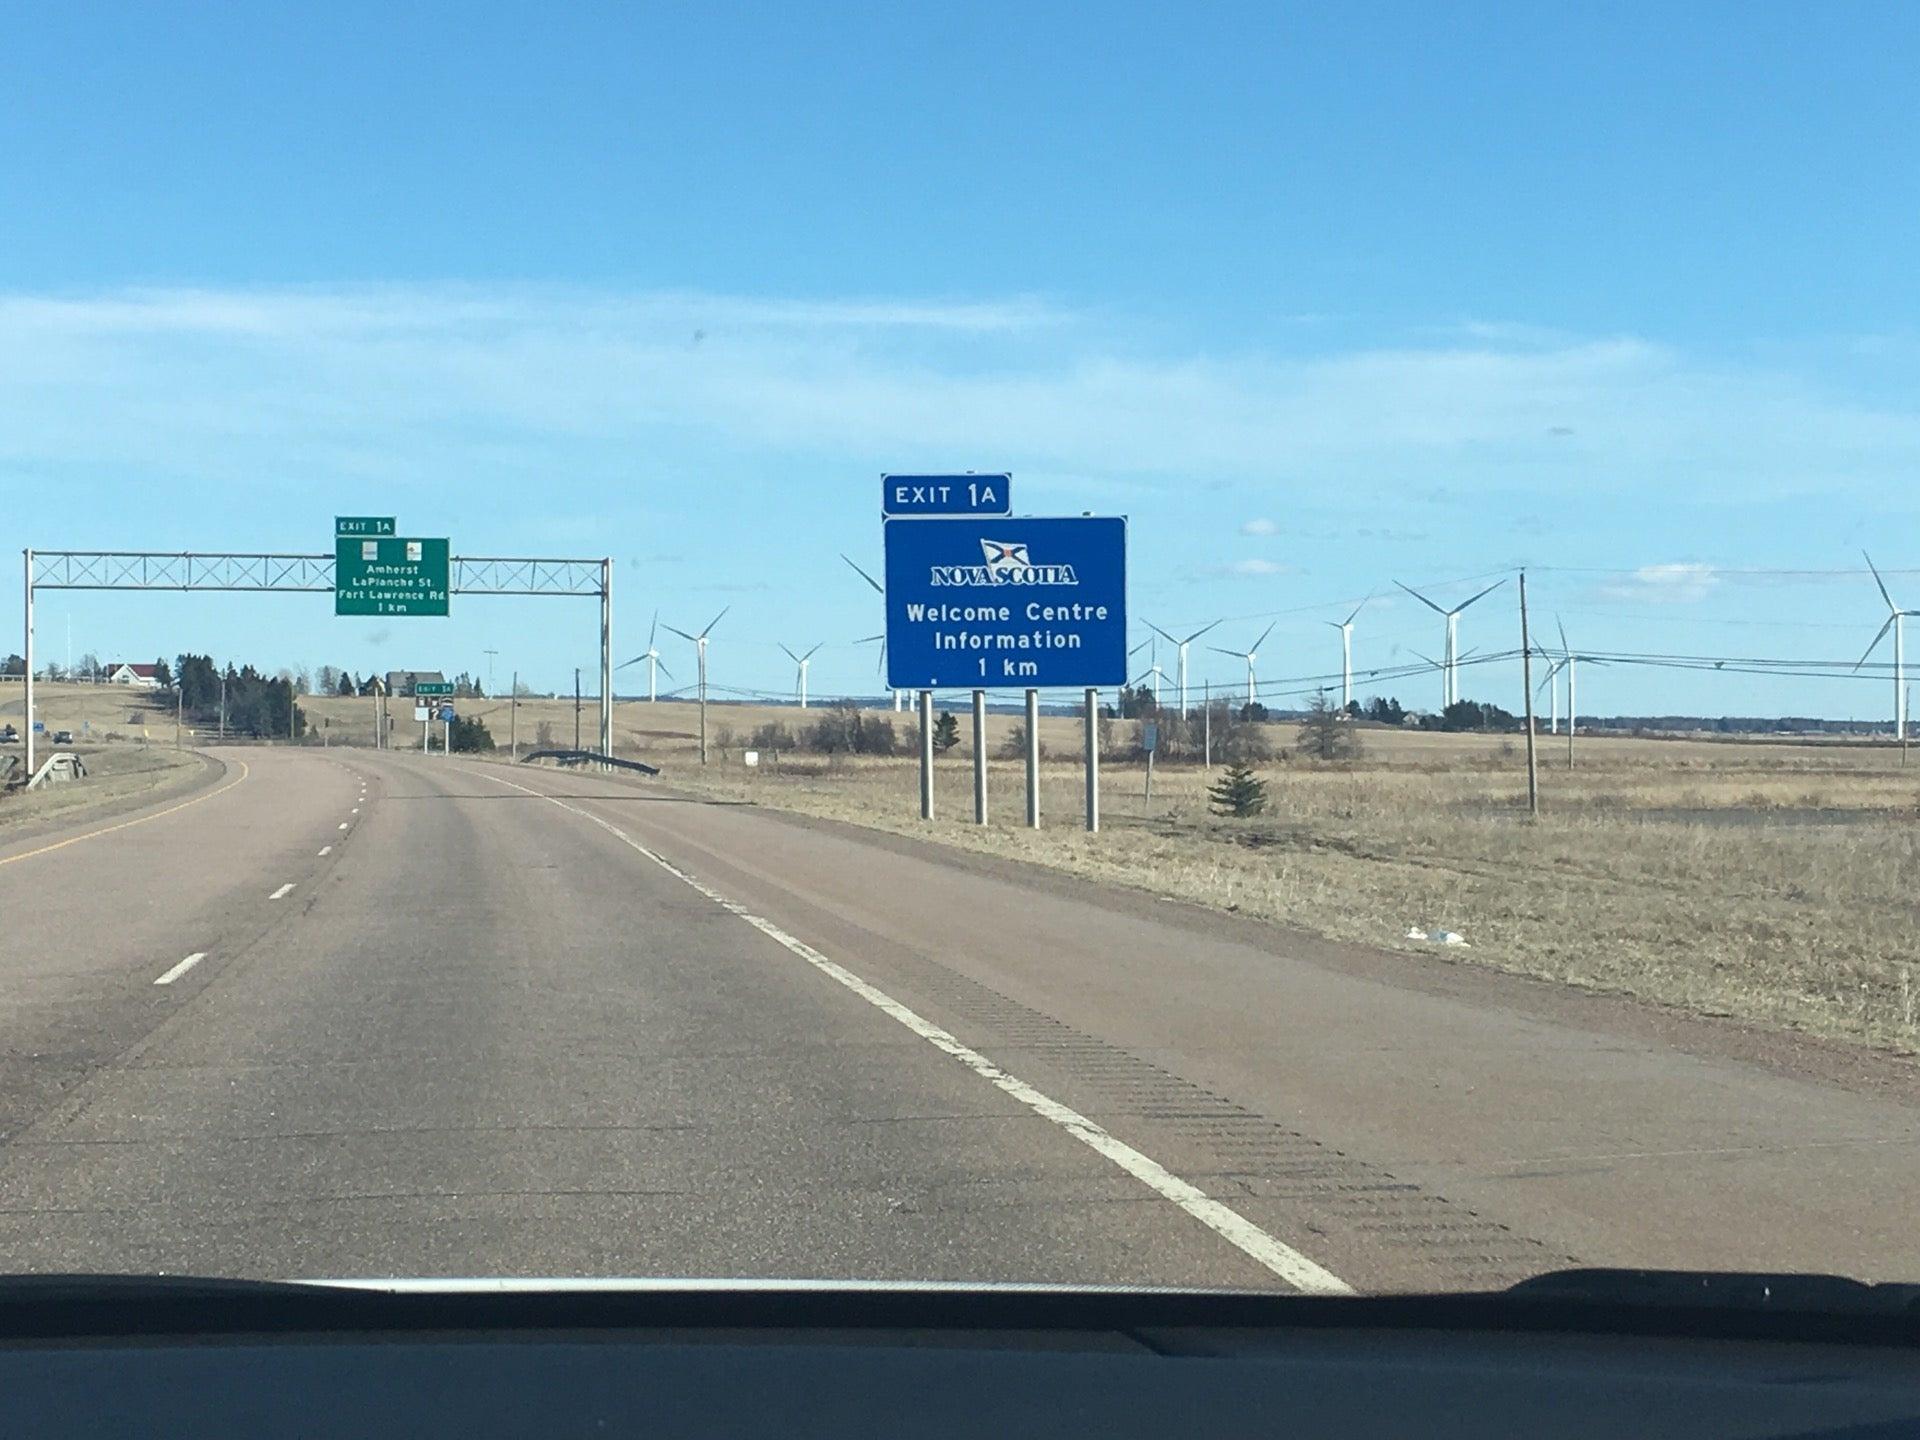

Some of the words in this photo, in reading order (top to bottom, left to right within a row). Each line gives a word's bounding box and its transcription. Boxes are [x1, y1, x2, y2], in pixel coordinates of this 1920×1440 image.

[896, 486, 951, 504] EXIT
[968, 483, 997, 507] 1A
[340, 522, 366, 531] EXIT
[376, 521, 391, 533] 1A
[366, 564, 418, 575] Amherst
[352, 577, 414, 587] LaPlanche
[339, 589, 365, 599] Fort
[369, 590, 424, 600] Lawrence
[378, 602, 383, 612] 1
[388, 602, 407, 612] km
[907, 604, 1010, 622] Welcome
[1026, 602, 1108, 621] Centre
[935, 631, 1081, 650] Information
[978, 657, 986, 677] 1
[1004, 658, 1038, 676] km
